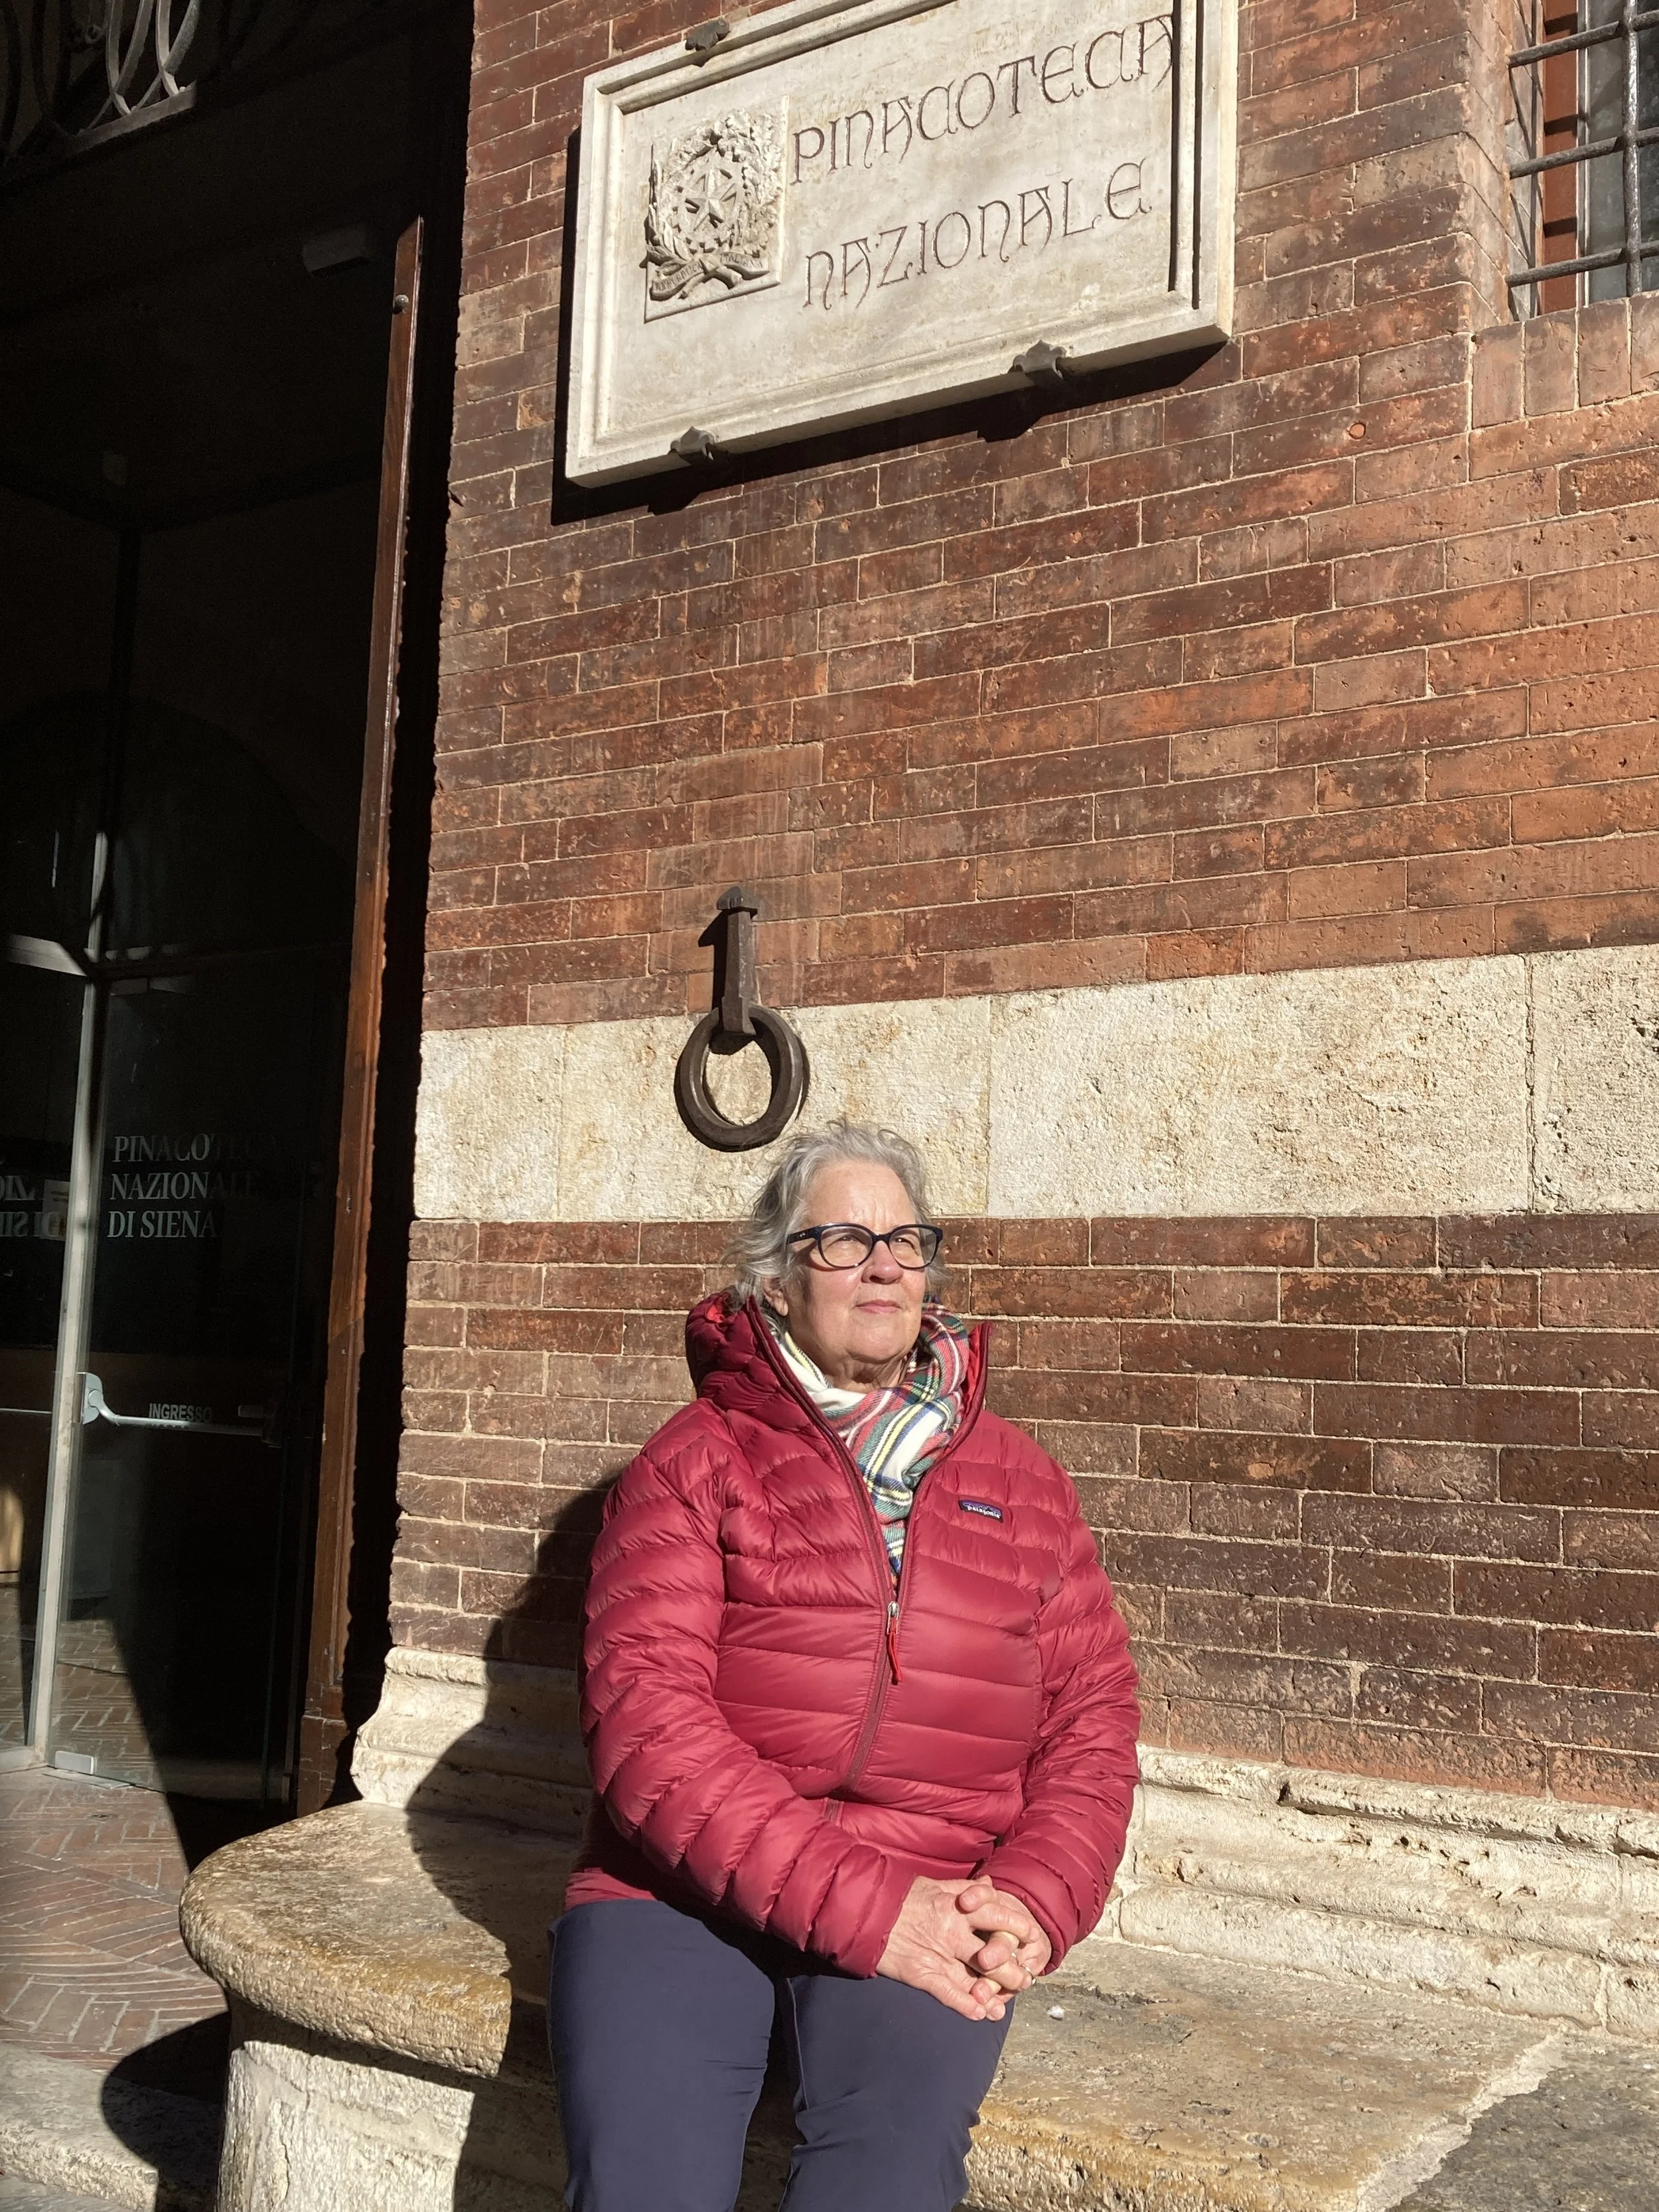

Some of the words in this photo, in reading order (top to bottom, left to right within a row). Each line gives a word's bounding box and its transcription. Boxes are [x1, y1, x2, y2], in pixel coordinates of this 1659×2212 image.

[790, 13, 1174, 186] PINACOTECA
[802, 157, 1152, 310] NAZIONALE
[107, 1210, 136, 1238] DI
[139, 1209, 218, 1238] SIENA
[148, 1402, 213, 1424] INGRESSO
